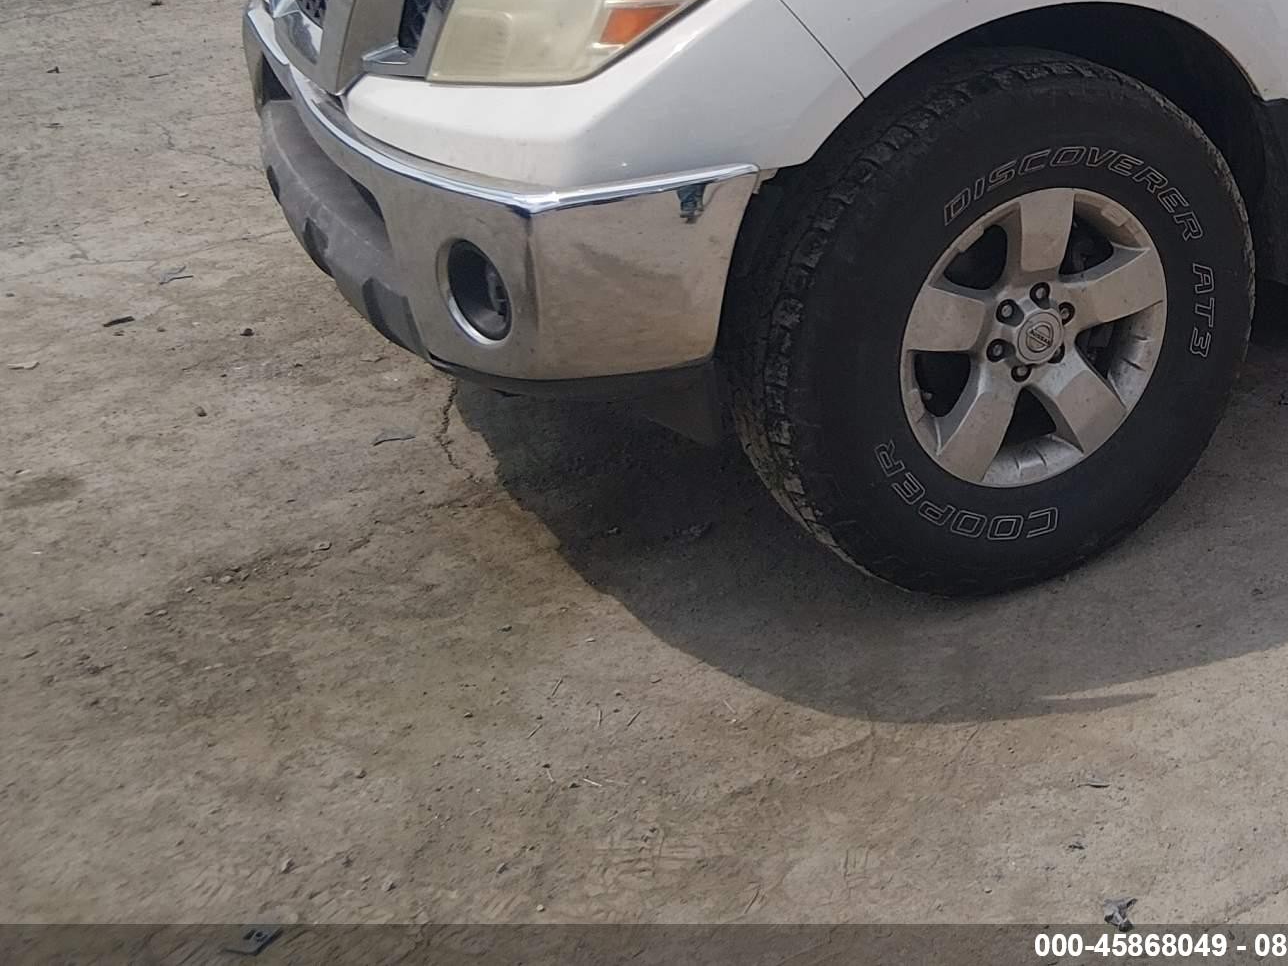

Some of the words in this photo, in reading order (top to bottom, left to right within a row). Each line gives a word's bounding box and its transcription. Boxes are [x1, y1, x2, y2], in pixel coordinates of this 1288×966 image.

[944, 146, 1203, 242] DISCOVERER
[1191, 264, 1216, 358] AT3
[875, 442, 1059, 540] COOPER
